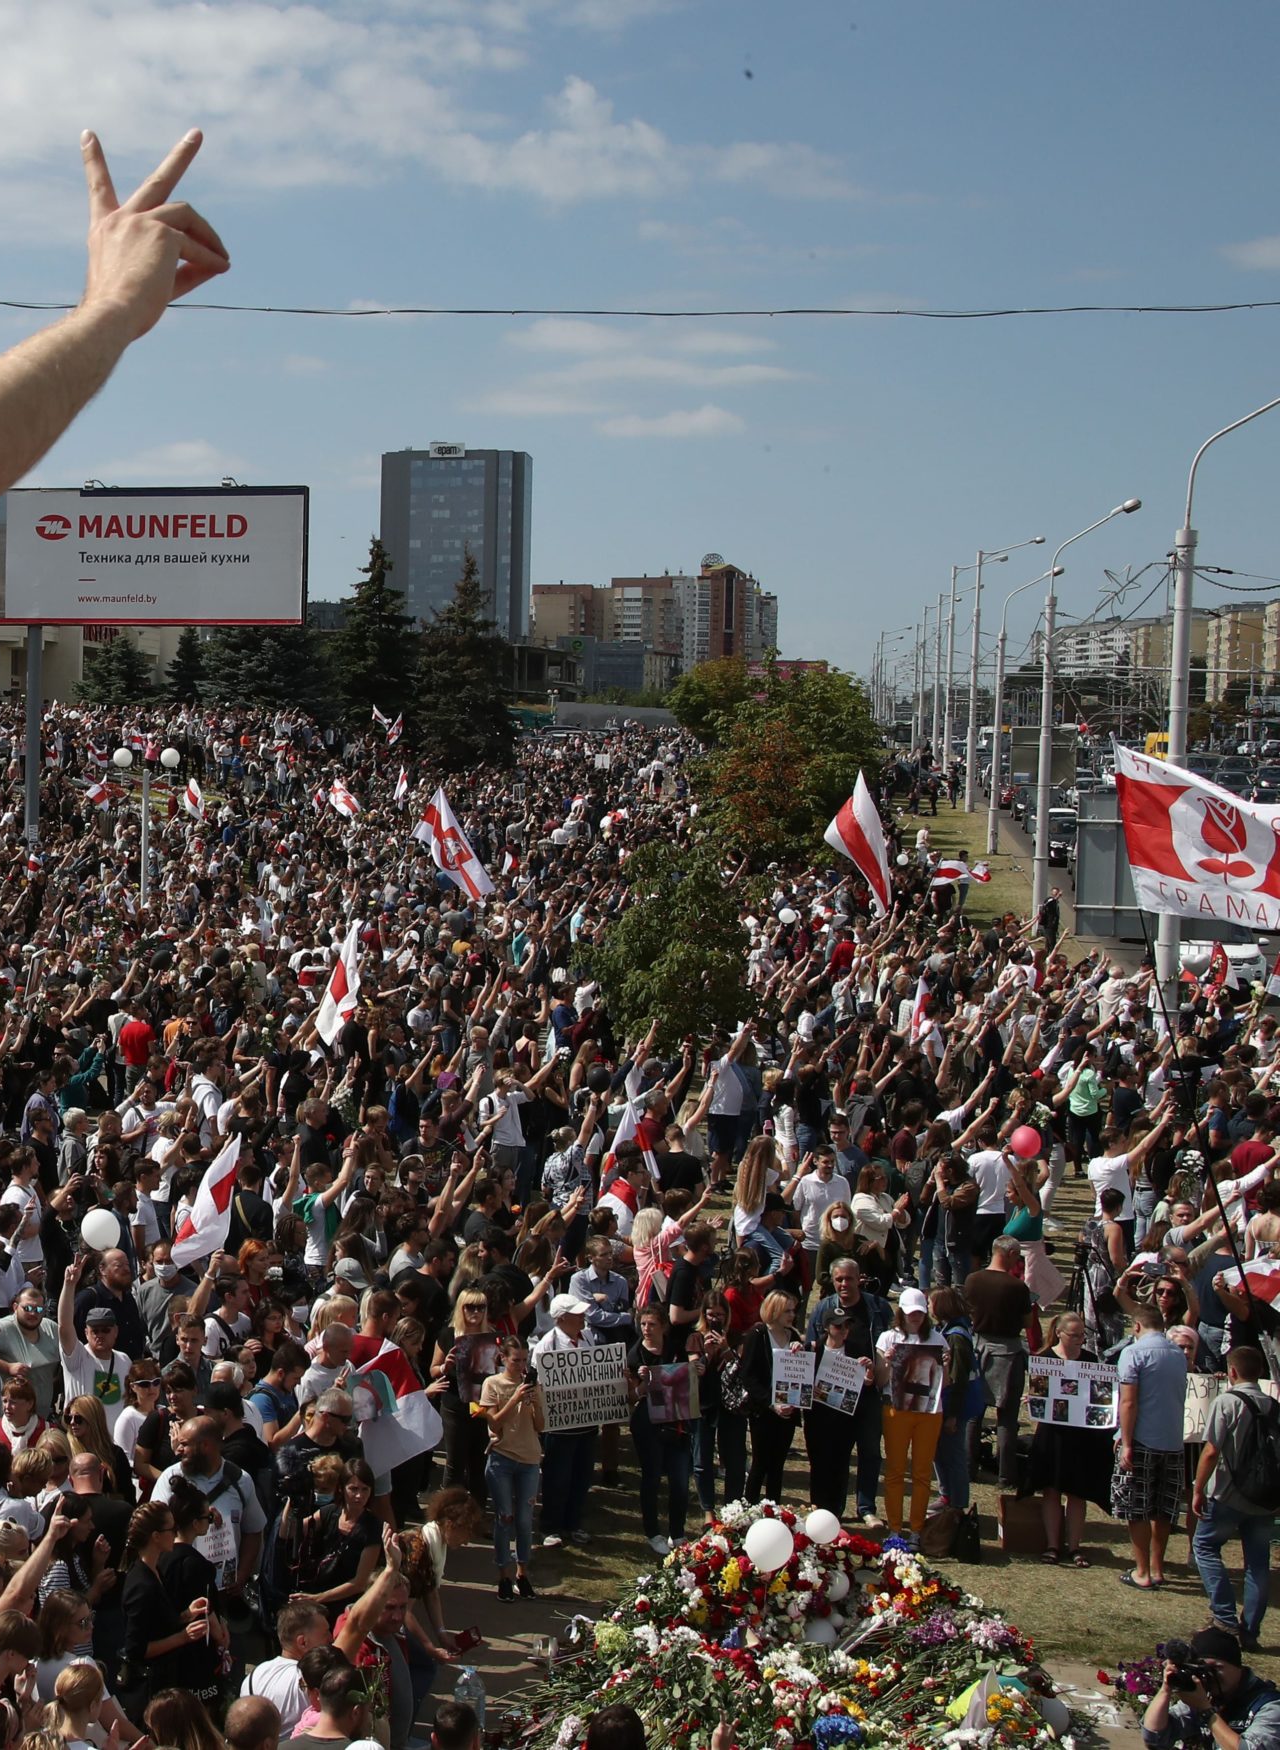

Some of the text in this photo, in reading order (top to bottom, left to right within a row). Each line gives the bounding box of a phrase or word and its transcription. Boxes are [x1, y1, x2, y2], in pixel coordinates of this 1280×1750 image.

[78, 514, 248, 538] MAUNFELD
[78, 551, 250, 566] Техника для вашей кухни
[78, 594, 157, 604] www.maunfeld.by
[1159, 881, 1280, 929] ГРАМА
[541, 1347, 623, 1370] СВОБОДУ
[1031, 1356, 1065, 1366] НЕЛЬЗЯ
[545, 1363, 624, 1387] ЗАКЛЮЧЕННЫМ
[1080, 1362, 1118, 1373] НЕЛЬЗЯ
[546, 1384, 616, 1403] ВЕЧНАЯ ПАМЯТЬ
[548, 1400, 590, 1416] ЖЕРТВАМ
